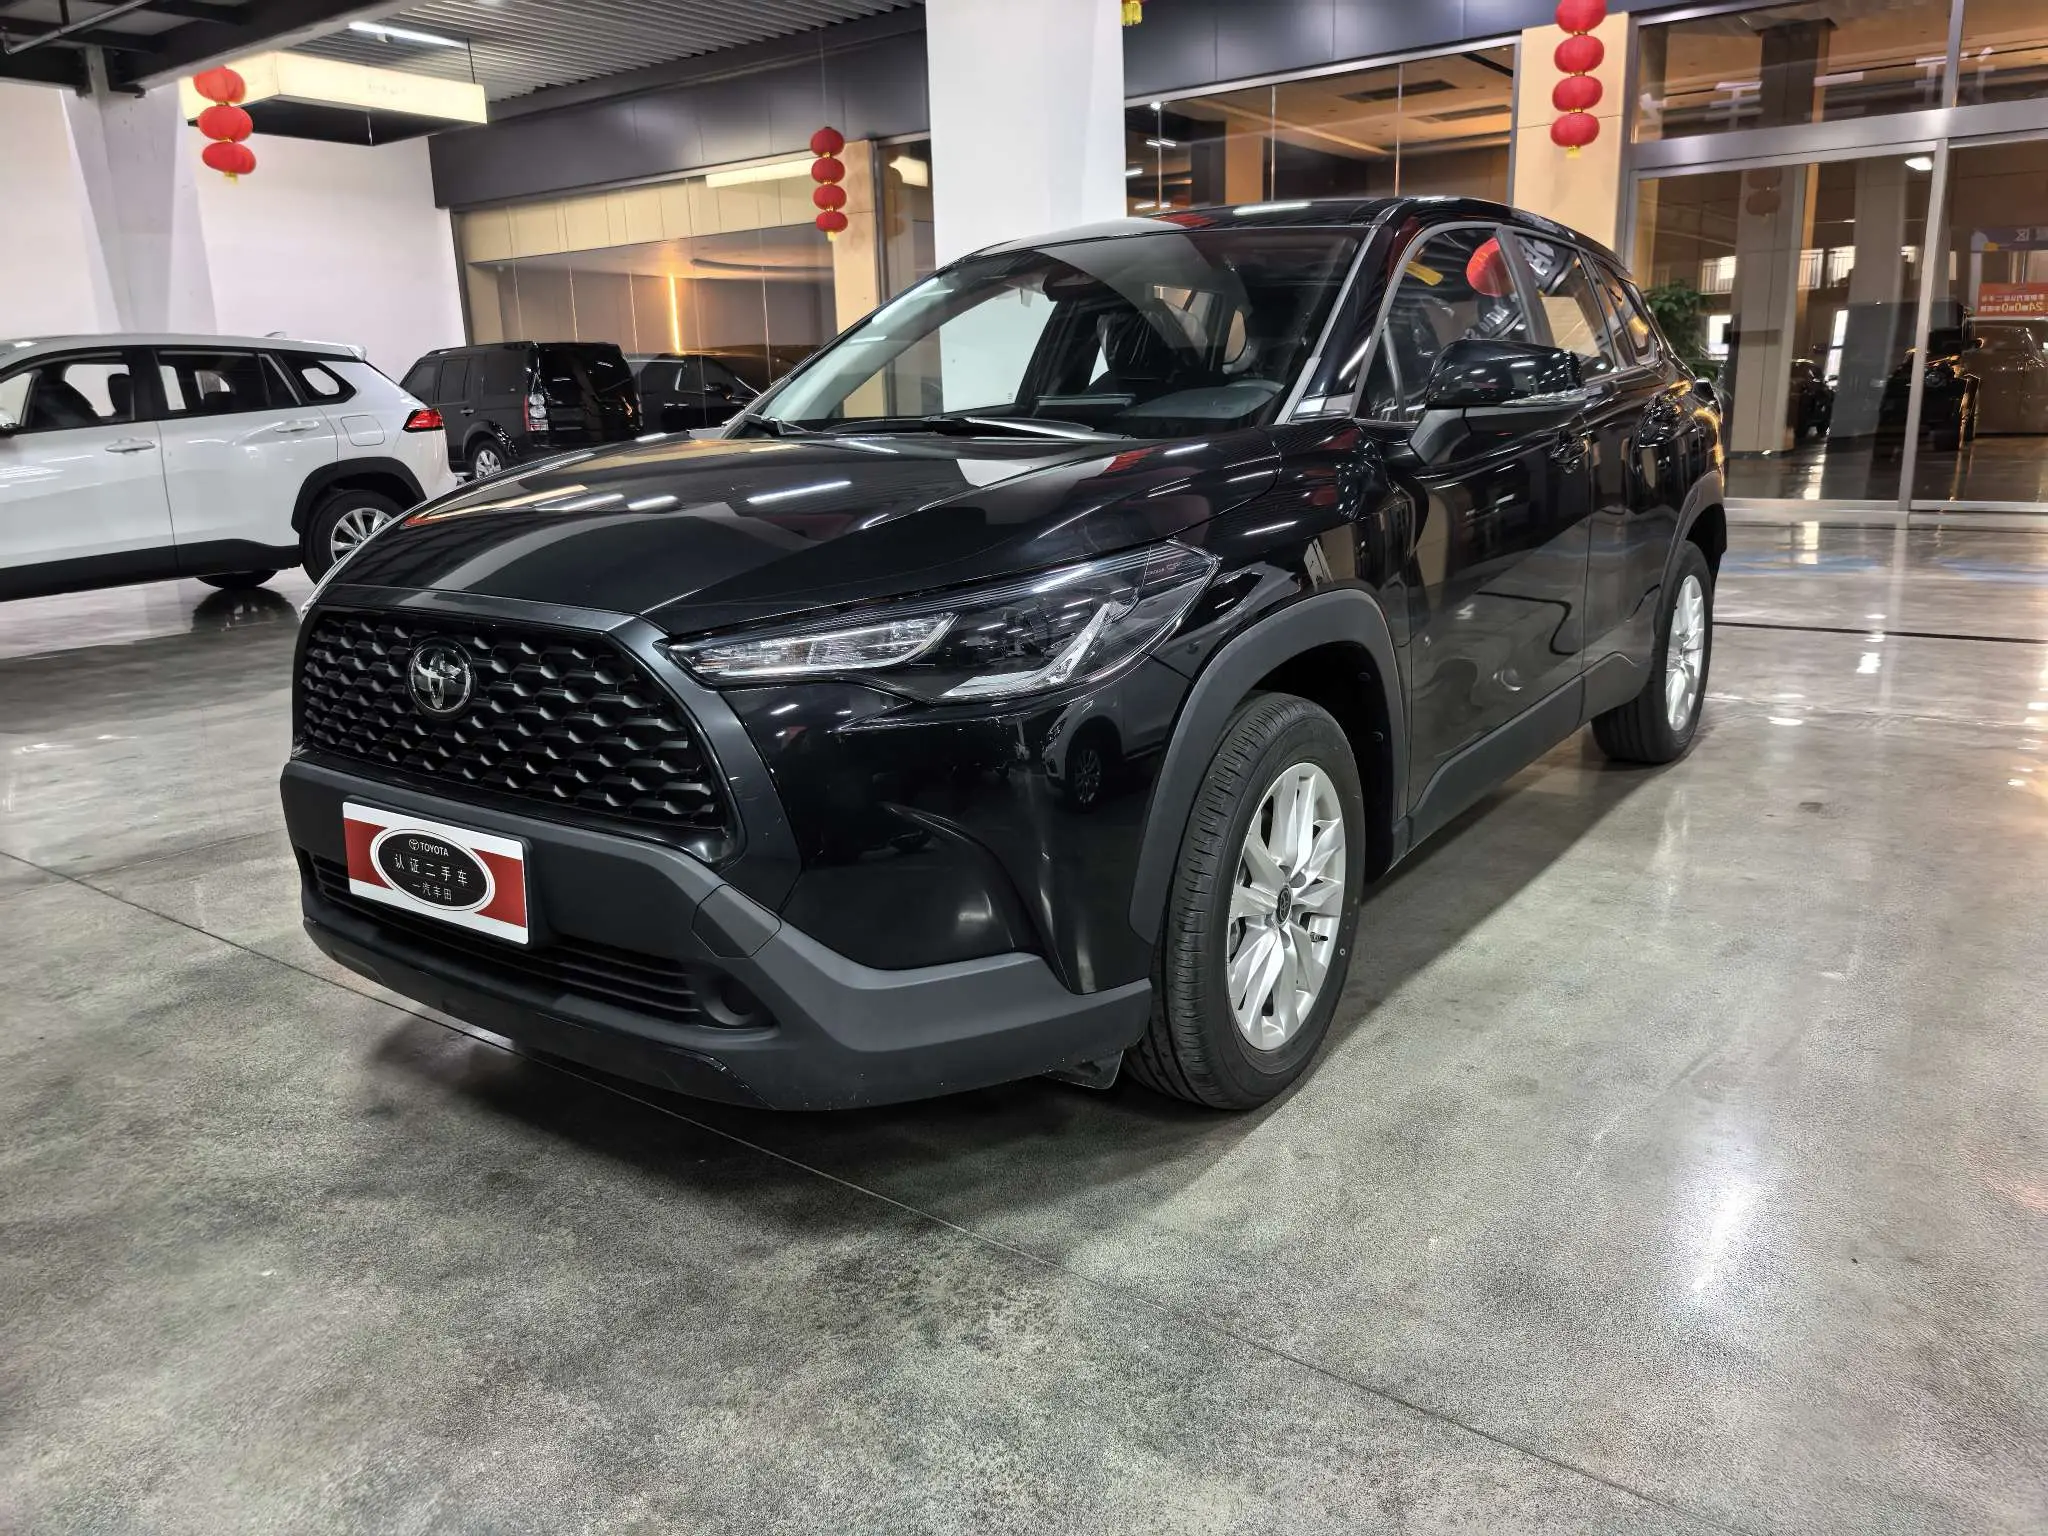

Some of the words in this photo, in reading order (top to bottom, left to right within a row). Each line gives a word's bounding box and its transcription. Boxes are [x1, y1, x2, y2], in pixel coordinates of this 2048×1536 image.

[420, 842, 449, 857] TOYOTA
[394, 853, 468, 887] 认证二手车
